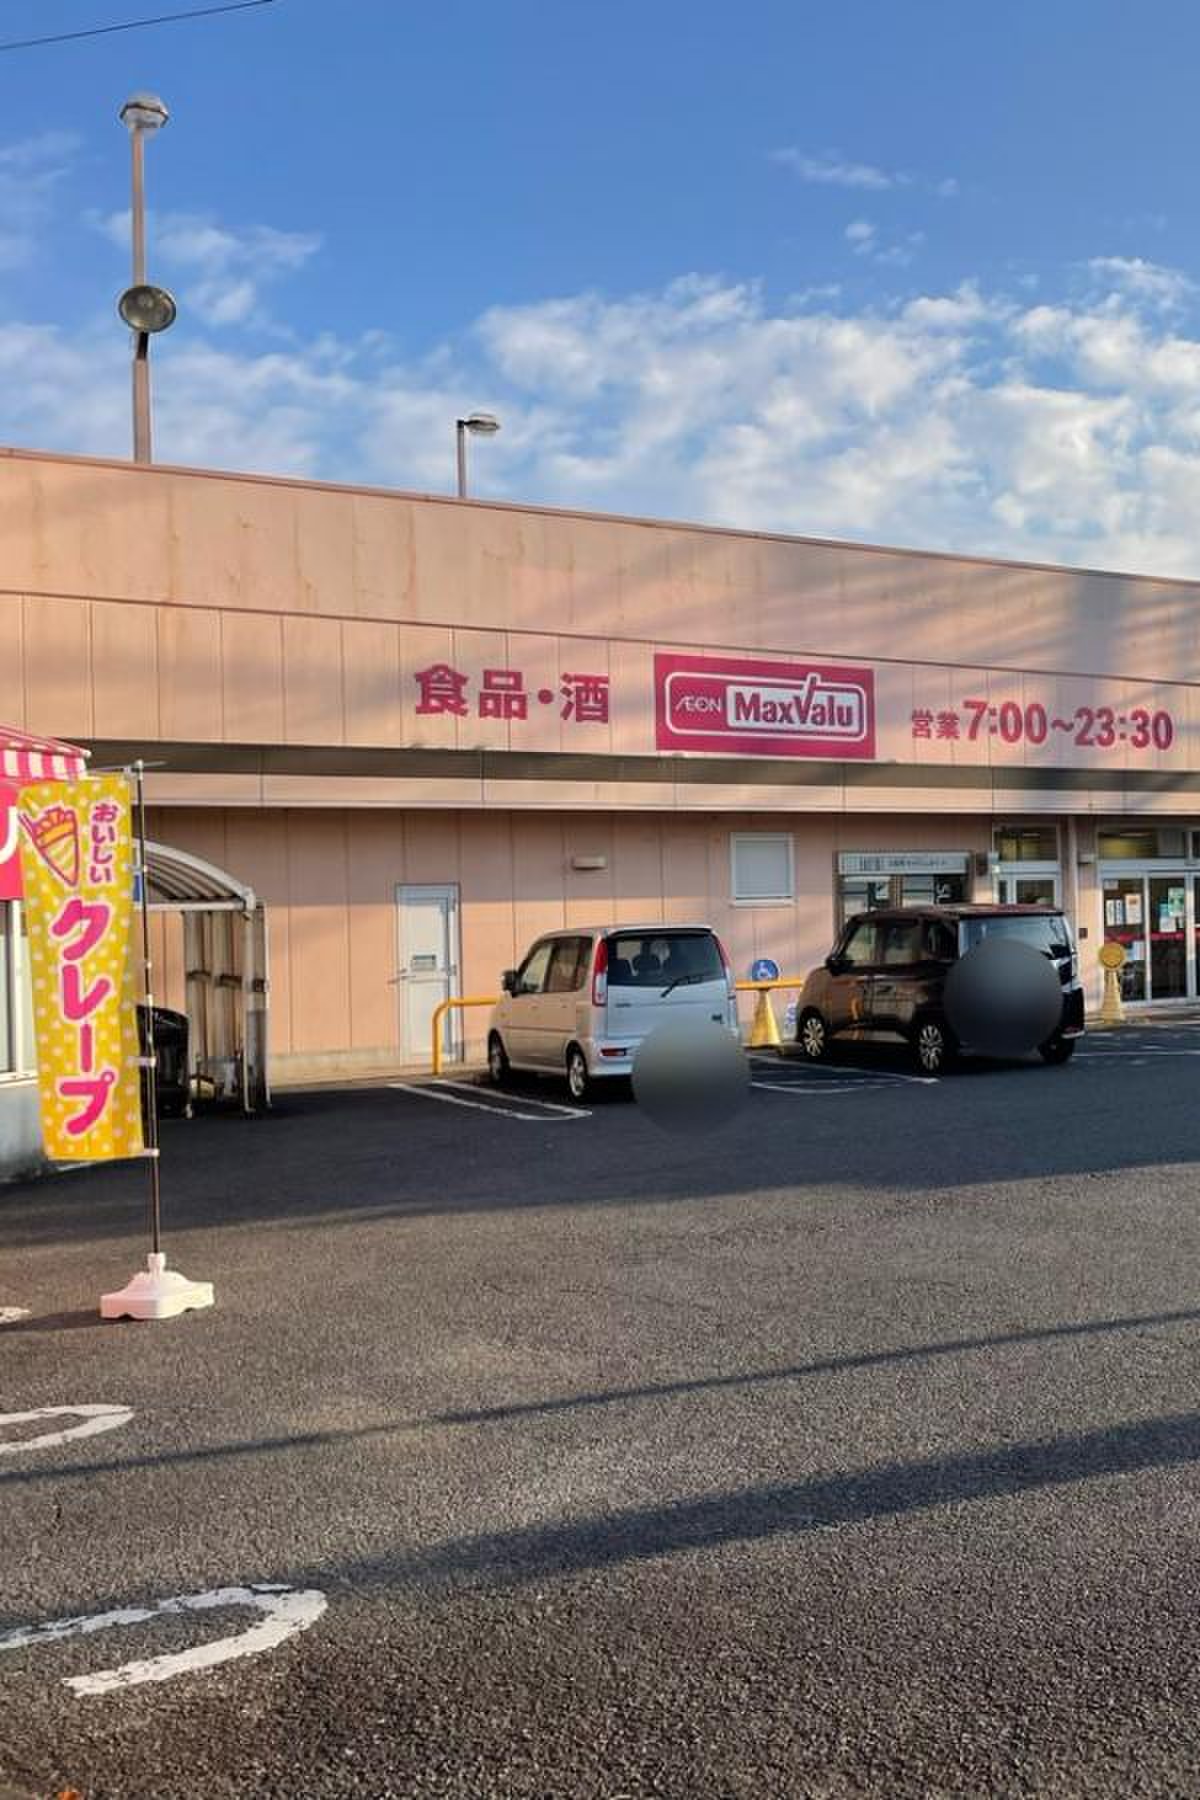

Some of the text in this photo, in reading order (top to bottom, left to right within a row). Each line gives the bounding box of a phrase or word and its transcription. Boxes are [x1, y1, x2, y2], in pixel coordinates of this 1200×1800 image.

[734, 675, 853, 728] MaxValu
[90, 803, 118, 884] おいしい
[53, 900, 116, 1136] クレープ
